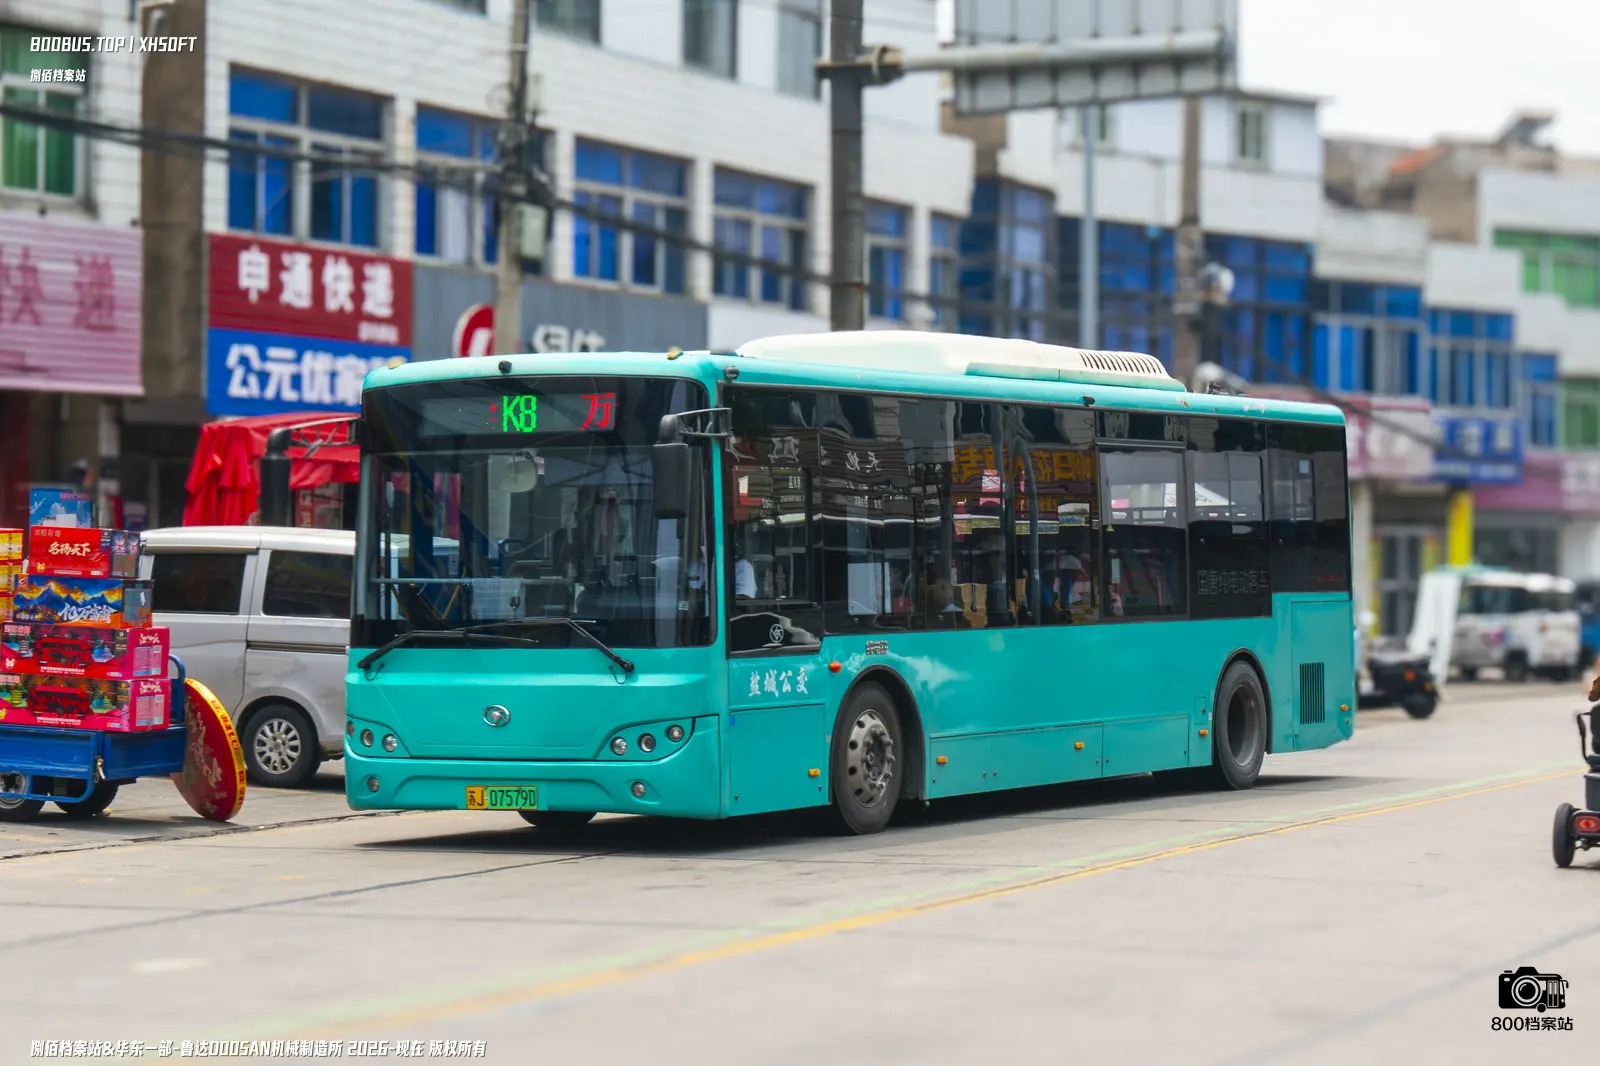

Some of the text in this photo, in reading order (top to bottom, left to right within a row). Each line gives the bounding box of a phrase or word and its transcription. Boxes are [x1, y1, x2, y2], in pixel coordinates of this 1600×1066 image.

[237, 244, 395, 318] 申通快递
[226, 342, 390, 407] 公元优家
[502, 392, 617, 433] K8 万
[48, 541, 91, 557] 名扬天下
[749, 667, 808, 697] 盐城公交
